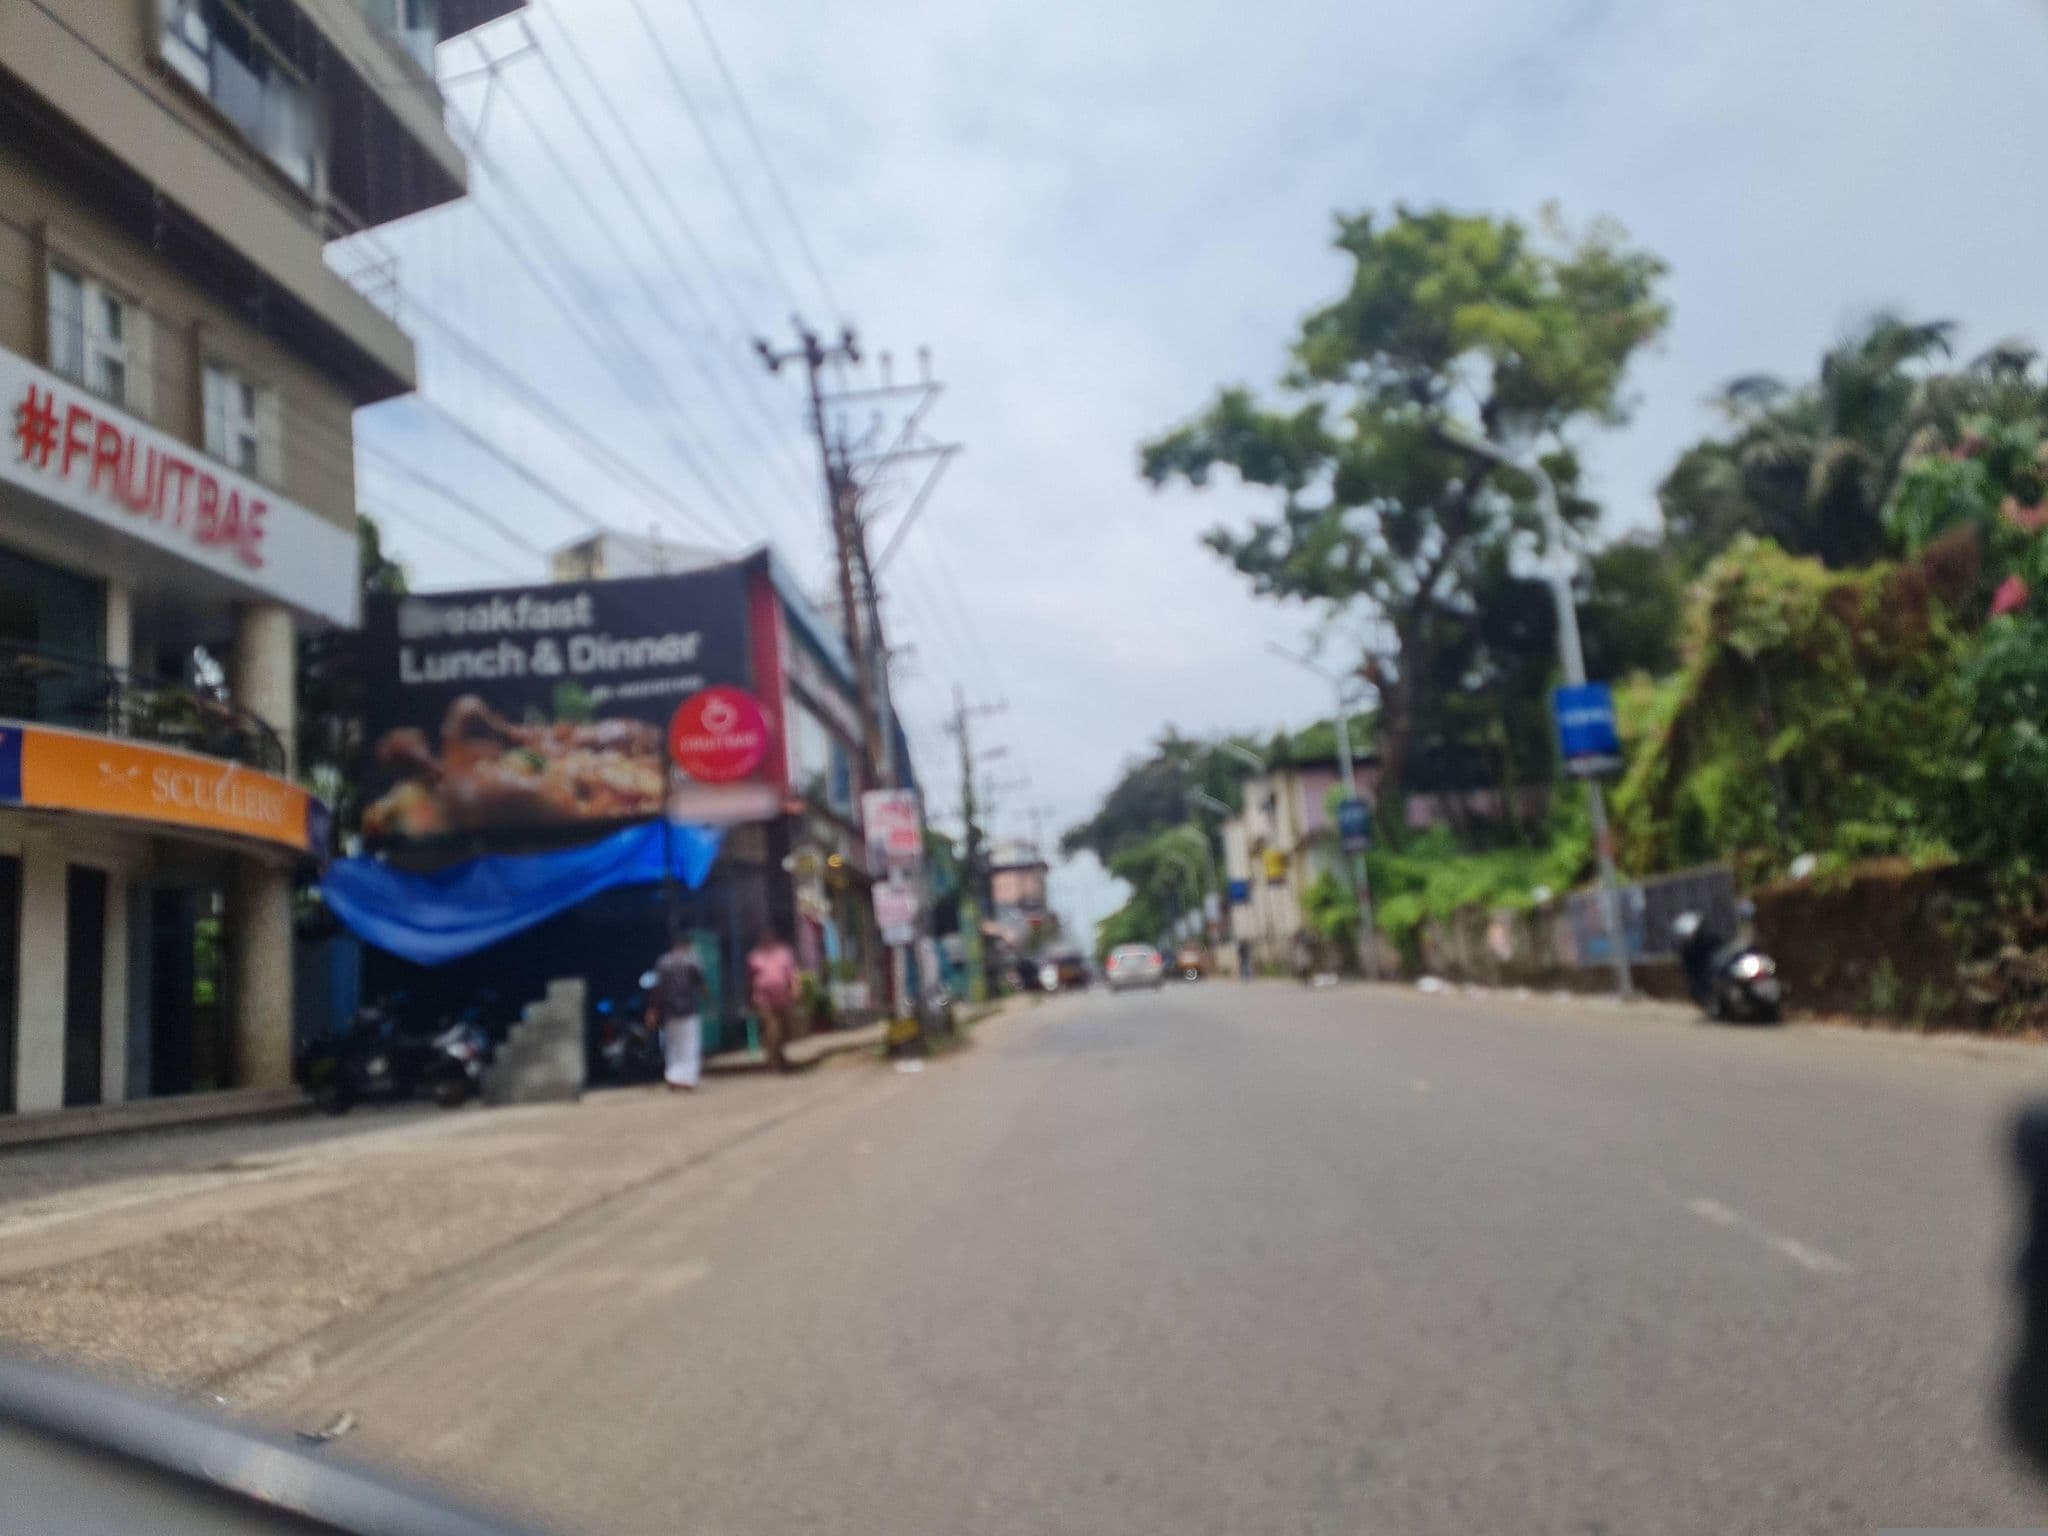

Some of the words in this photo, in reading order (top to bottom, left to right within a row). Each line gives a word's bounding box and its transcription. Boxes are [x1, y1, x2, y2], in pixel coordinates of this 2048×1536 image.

[400, 593, 593, 639] eakfast
[401, 638, 524, 684] Lunch
[529, 638, 563, 676] &
[568, 631, 700, 673] Dinner
